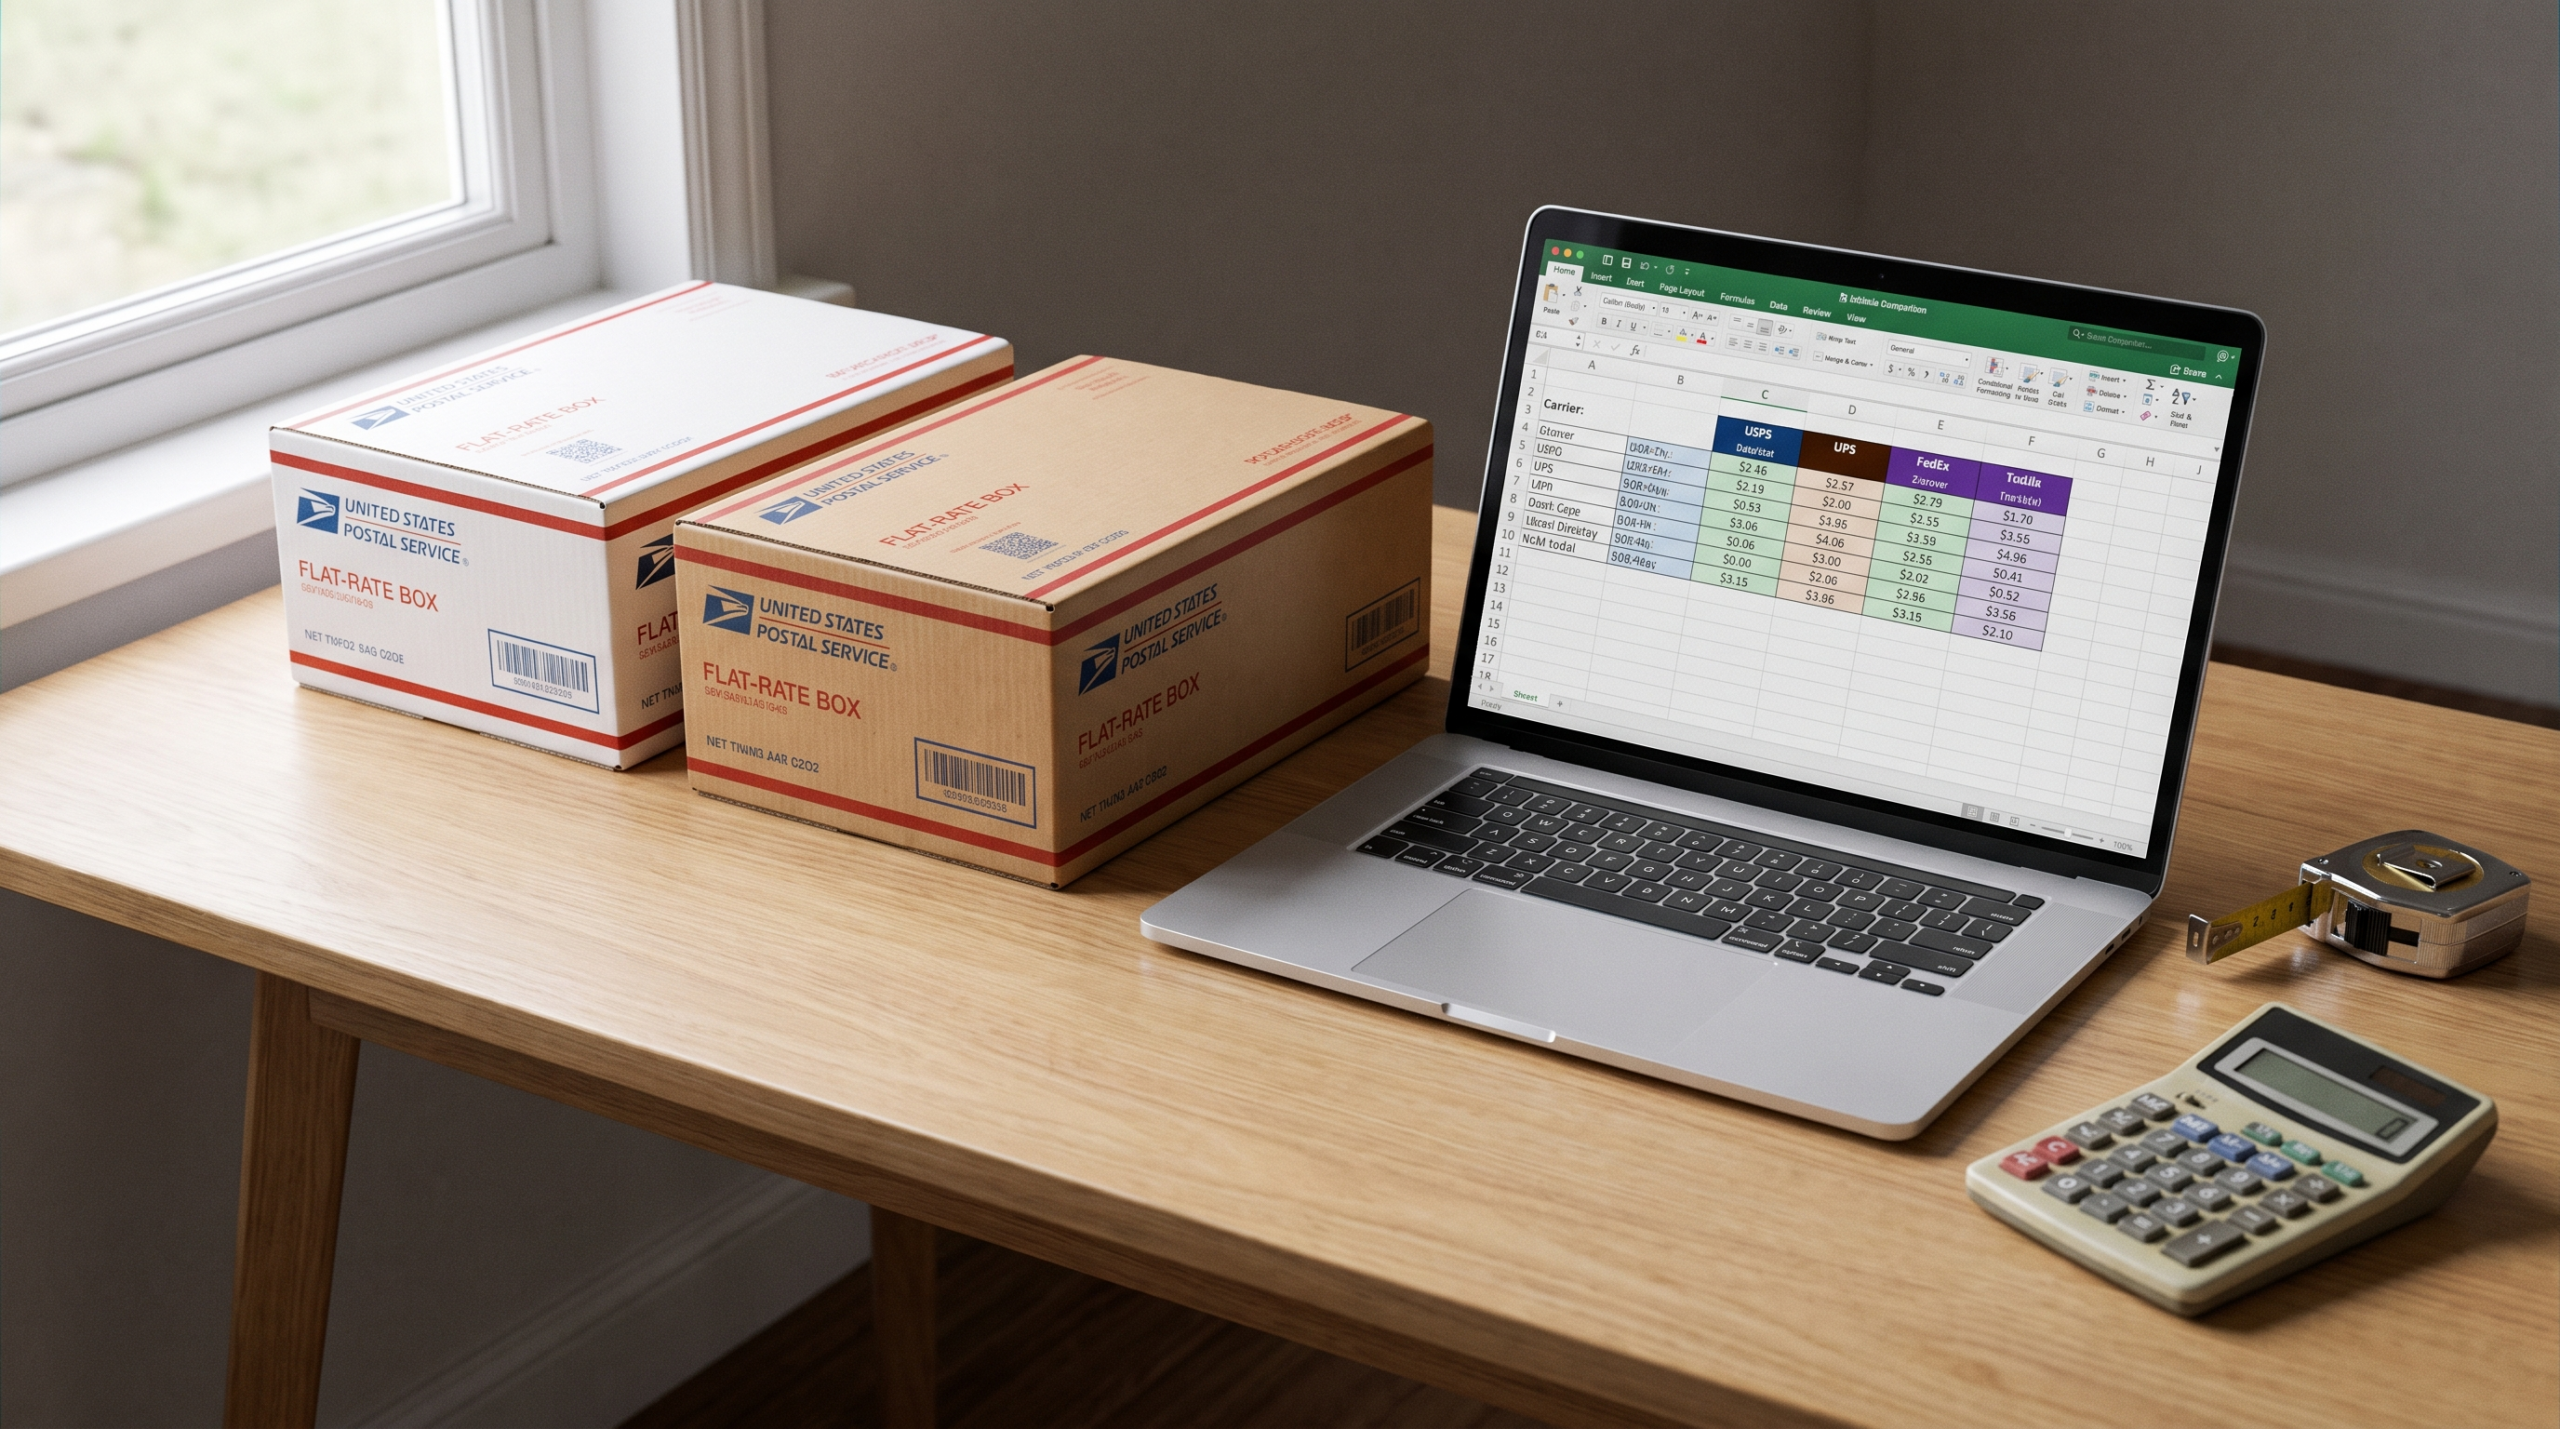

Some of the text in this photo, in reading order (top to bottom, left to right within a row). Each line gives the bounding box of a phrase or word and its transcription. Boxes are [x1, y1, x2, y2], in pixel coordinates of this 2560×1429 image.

[1553, 266, 1576, 277] Home
[1659, 282, 1705, 299] Page Layout
[1720, 292, 1756, 306] Formulas
[1769, 300, 1788, 311] Data
[1802, 306, 1832, 319] Review
[1846, 313, 1867, 324] View
[1588, 360, 1596, 370] A
[1531, 370, 1537, 379] 1
[1677, 375, 1684, 385] B
[1527, 387, 1534, 396] 2
[1761, 390, 1769, 399] C
[1525, 405, 1531, 414] 3
[1543, 398, 1584, 415] Carrier:
[1848, 405, 1857, 415] D
[456, 411, 563, 452] FLAT-RATE
[558, 396, 607, 414] BOX
[1521, 422, 1529, 432] 4
[1937, 420, 1944, 430] E
[1745, 426, 1772, 440] USPS
[1519, 440, 1525, 449] 5
[2028, 436, 2035, 446] F
[1834, 442, 1856, 455] UPS
[2097, 448, 2105, 458] G
[1516, 458, 1523, 467] 6
[1534, 461, 1554, 474] UPS
[1916, 457, 1950, 471] FedEx
[2146, 457, 2155, 467] H
[803, 451, 915, 498] UNITED STATES
[821, 454, 942, 506] POSTAL SERVICE
[1513, 476, 1520, 486] 7
[1736, 480, 1764, 494] $2.19
[1826, 478, 1854, 492] $2.57
[1510, 494, 1517, 503] 8
[1822, 496, 1851, 510] $2.00
[1913, 494, 1943, 508] $2.79
[1733, 499, 1761, 513] $0.53
[346, 498, 455, 537] UNITED STATES
[879, 500, 989, 547] FLAT-RATE
[980, 483, 1030, 504] BOX
[1507, 512, 1514, 522] 9
[1910, 513, 1939, 527] $2.55
[2003, 510, 2033, 525] $1.70
[1730, 517, 1758, 531] $3.06
[1502, 529, 1515, 540] 10
[1816, 534, 1845, 548] $4.06
[1906, 532, 1936, 546] $3.59
[2000, 530, 2030, 544] $3.55
[344, 523, 461, 564] POSTAL SERVICE
[1548, 538, 1576, 554] todal
[1726, 536, 1755, 550] $0.06
[1499, 547, 1511, 558] 11
[1812, 552, 1841, 567] $3.00
[1903, 551, 1932, 565] $2.55
[1997, 549, 2027, 564] $4.96
[1723, 554, 1752, 568] $0.00
[1496, 565, 1508, 575] 12
[1900, 569, 1929, 584] $2.02
[1720, 572, 1748, 587] $3.15
[1809, 571, 1838, 585] $2.06
[299, 560, 394, 601] FLAT-RATE
[400, 586, 439, 612] BOX
[1493, 582, 1505, 593] 13
[1989, 587, 2019, 602] $0.52
[1490, 600, 1503, 611] 14
[760, 597, 884, 640] UNITED STATES
[1124, 583, 1218, 645] UNITED STATES
[1892, 607, 1922, 622] $3.15
[1487, 618, 1500, 629] 15
[305, 629, 322, 642] NET
[1982, 625, 2013, 640] $2.10
[757, 623, 891, 670] POSTAL SERVICE
[1121, 608, 1222, 675] POSTAL SERVICE
[1484, 636, 1497, 647] 16
[1481, 653, 1494, 664] 17
[703, 661, 810, 707] FLAT-RATE
[816, 690, 862, 720] BOX
[641, 692, 660, 709] NET
[1078, 692, 1163, 755] FLAT-RATE
[1166, 672, 1200, 708] BOX
[706, 735, 728, 750] NET
[1080, 807, 1097, 823] NET
[1539, 819, 1552, 827] W
[1527, 837, 1539, 845] S
[2253, 915, 2259, 927] 2
[2155, 1133, 2176, 1144] 7
[2159, 1166, 2180, 1179] 5
[2126, 1182, 2148, 1195] 2
[2198, 1187, 2219, 1199] 6
